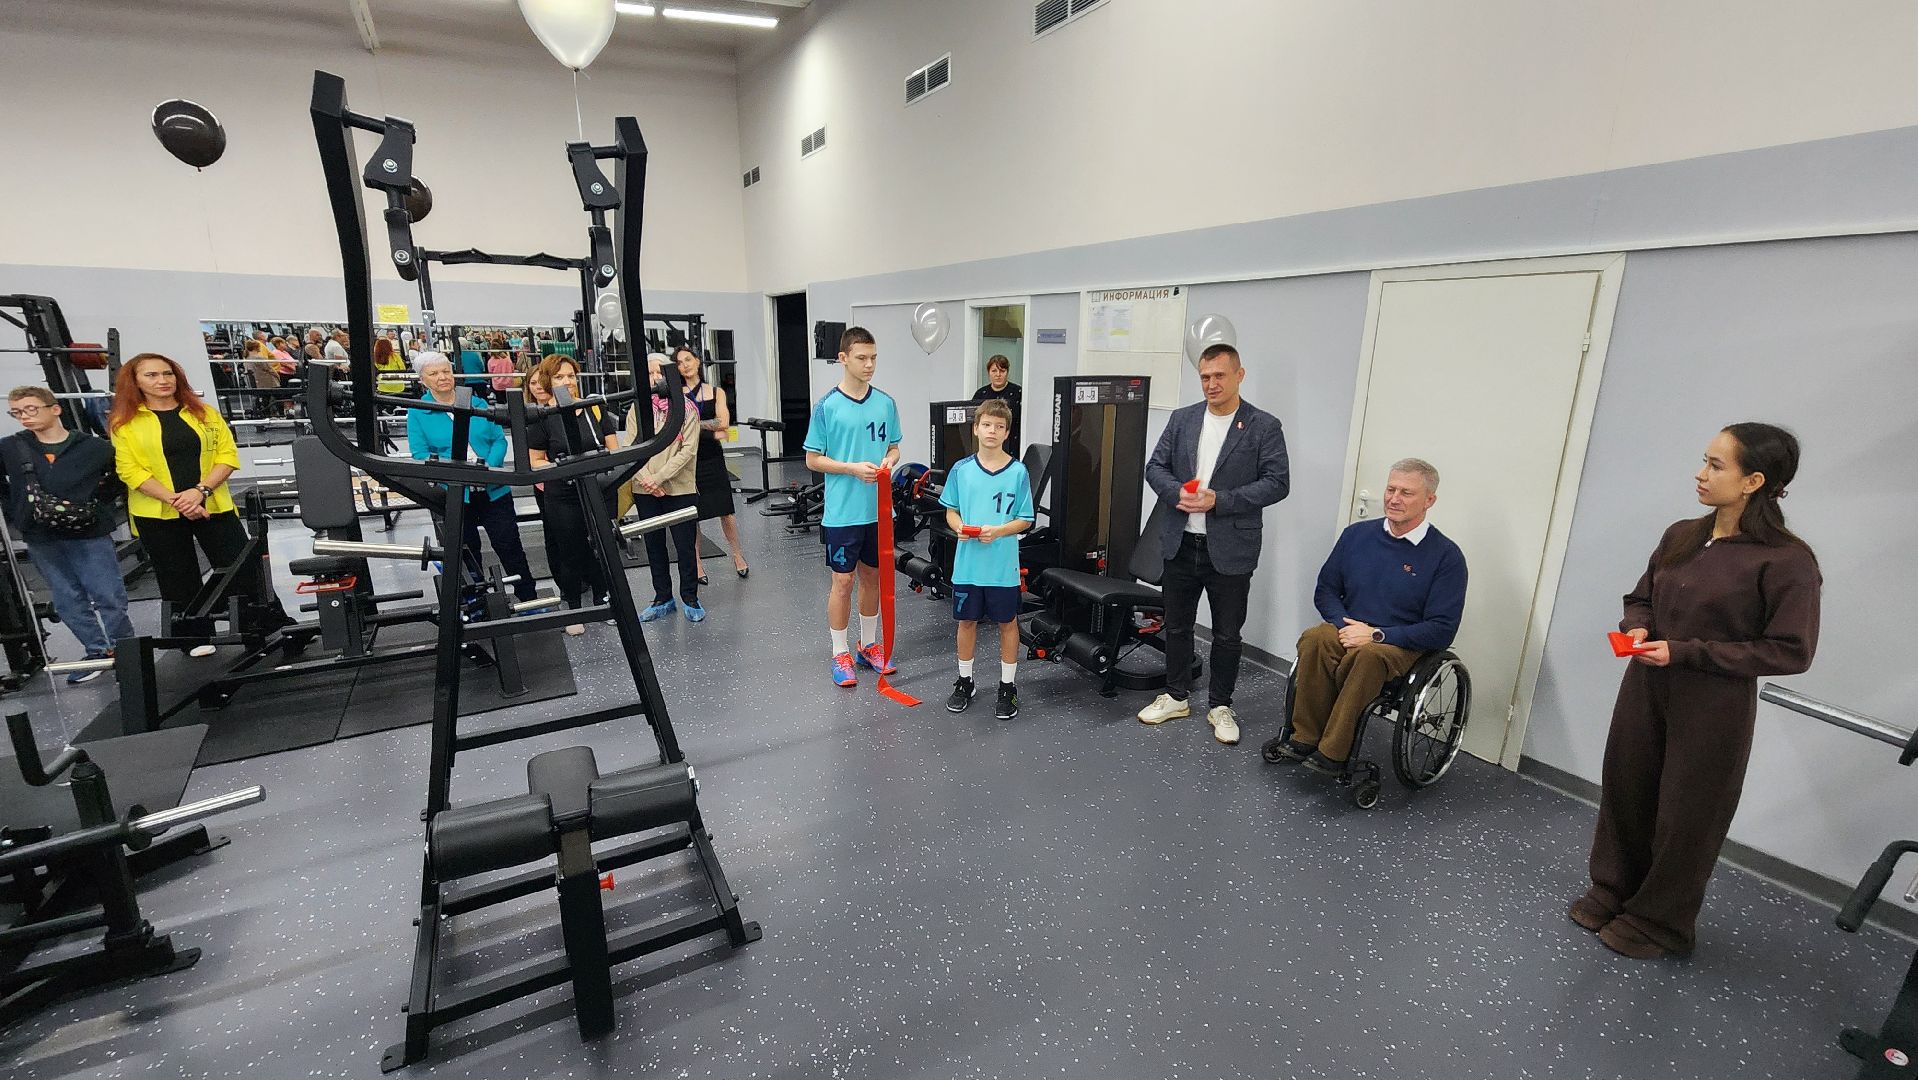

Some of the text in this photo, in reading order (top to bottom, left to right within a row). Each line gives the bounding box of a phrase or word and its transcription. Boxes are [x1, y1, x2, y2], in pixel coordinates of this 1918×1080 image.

[1103, 289, 1170, 302] ИНФОРМАЦИЯ
[1053, 393, 1063, 443] FOREMAN
[866, 421, 887, 442] 14
[992, 491, 1016, 515] 17
[951, 589, 969, 613] 7
